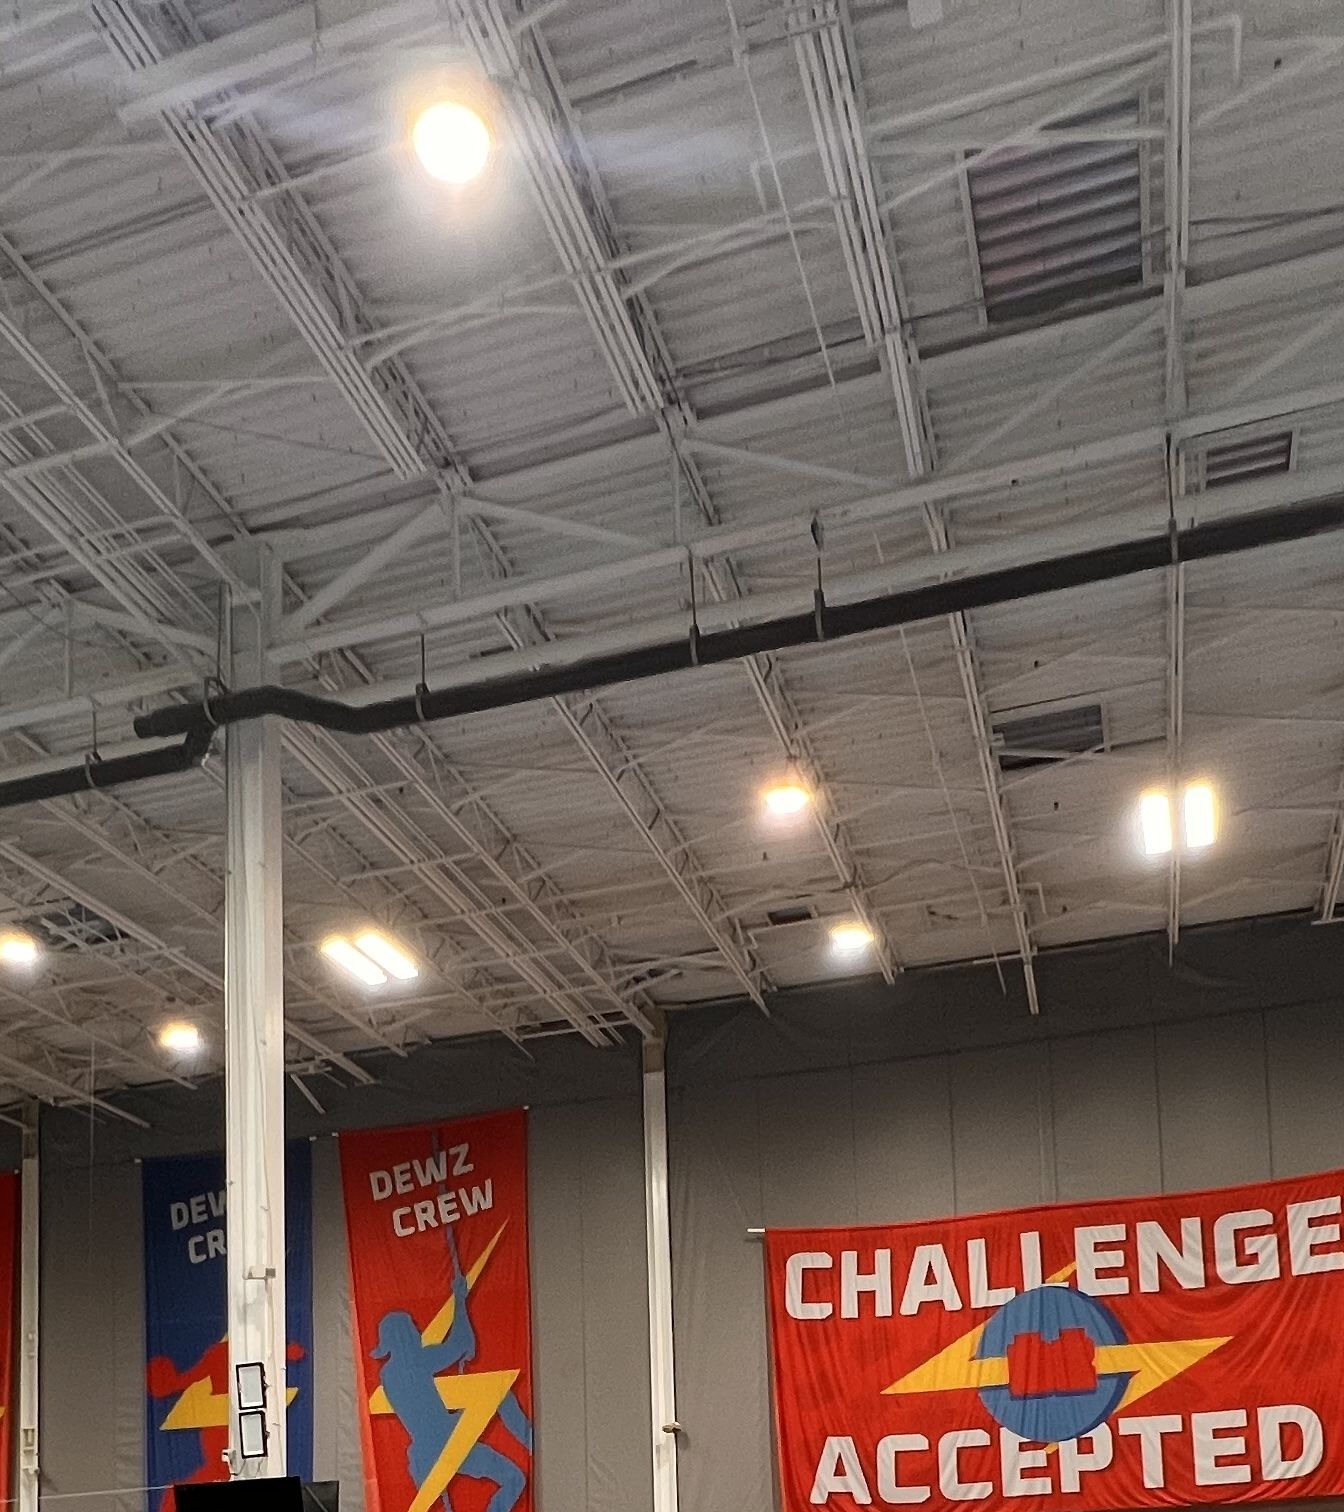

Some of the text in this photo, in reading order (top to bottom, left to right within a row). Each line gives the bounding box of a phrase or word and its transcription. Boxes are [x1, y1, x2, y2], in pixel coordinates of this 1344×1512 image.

[369, 1142, 476, 1201] DEWZ
[170, 1189, 227, 1231] DEW
[392, 1177, 494, 1238] CREW
[188, 1228, 227, 1264] CR
[809, 1404, 1325, 1506] ACCEPTED
